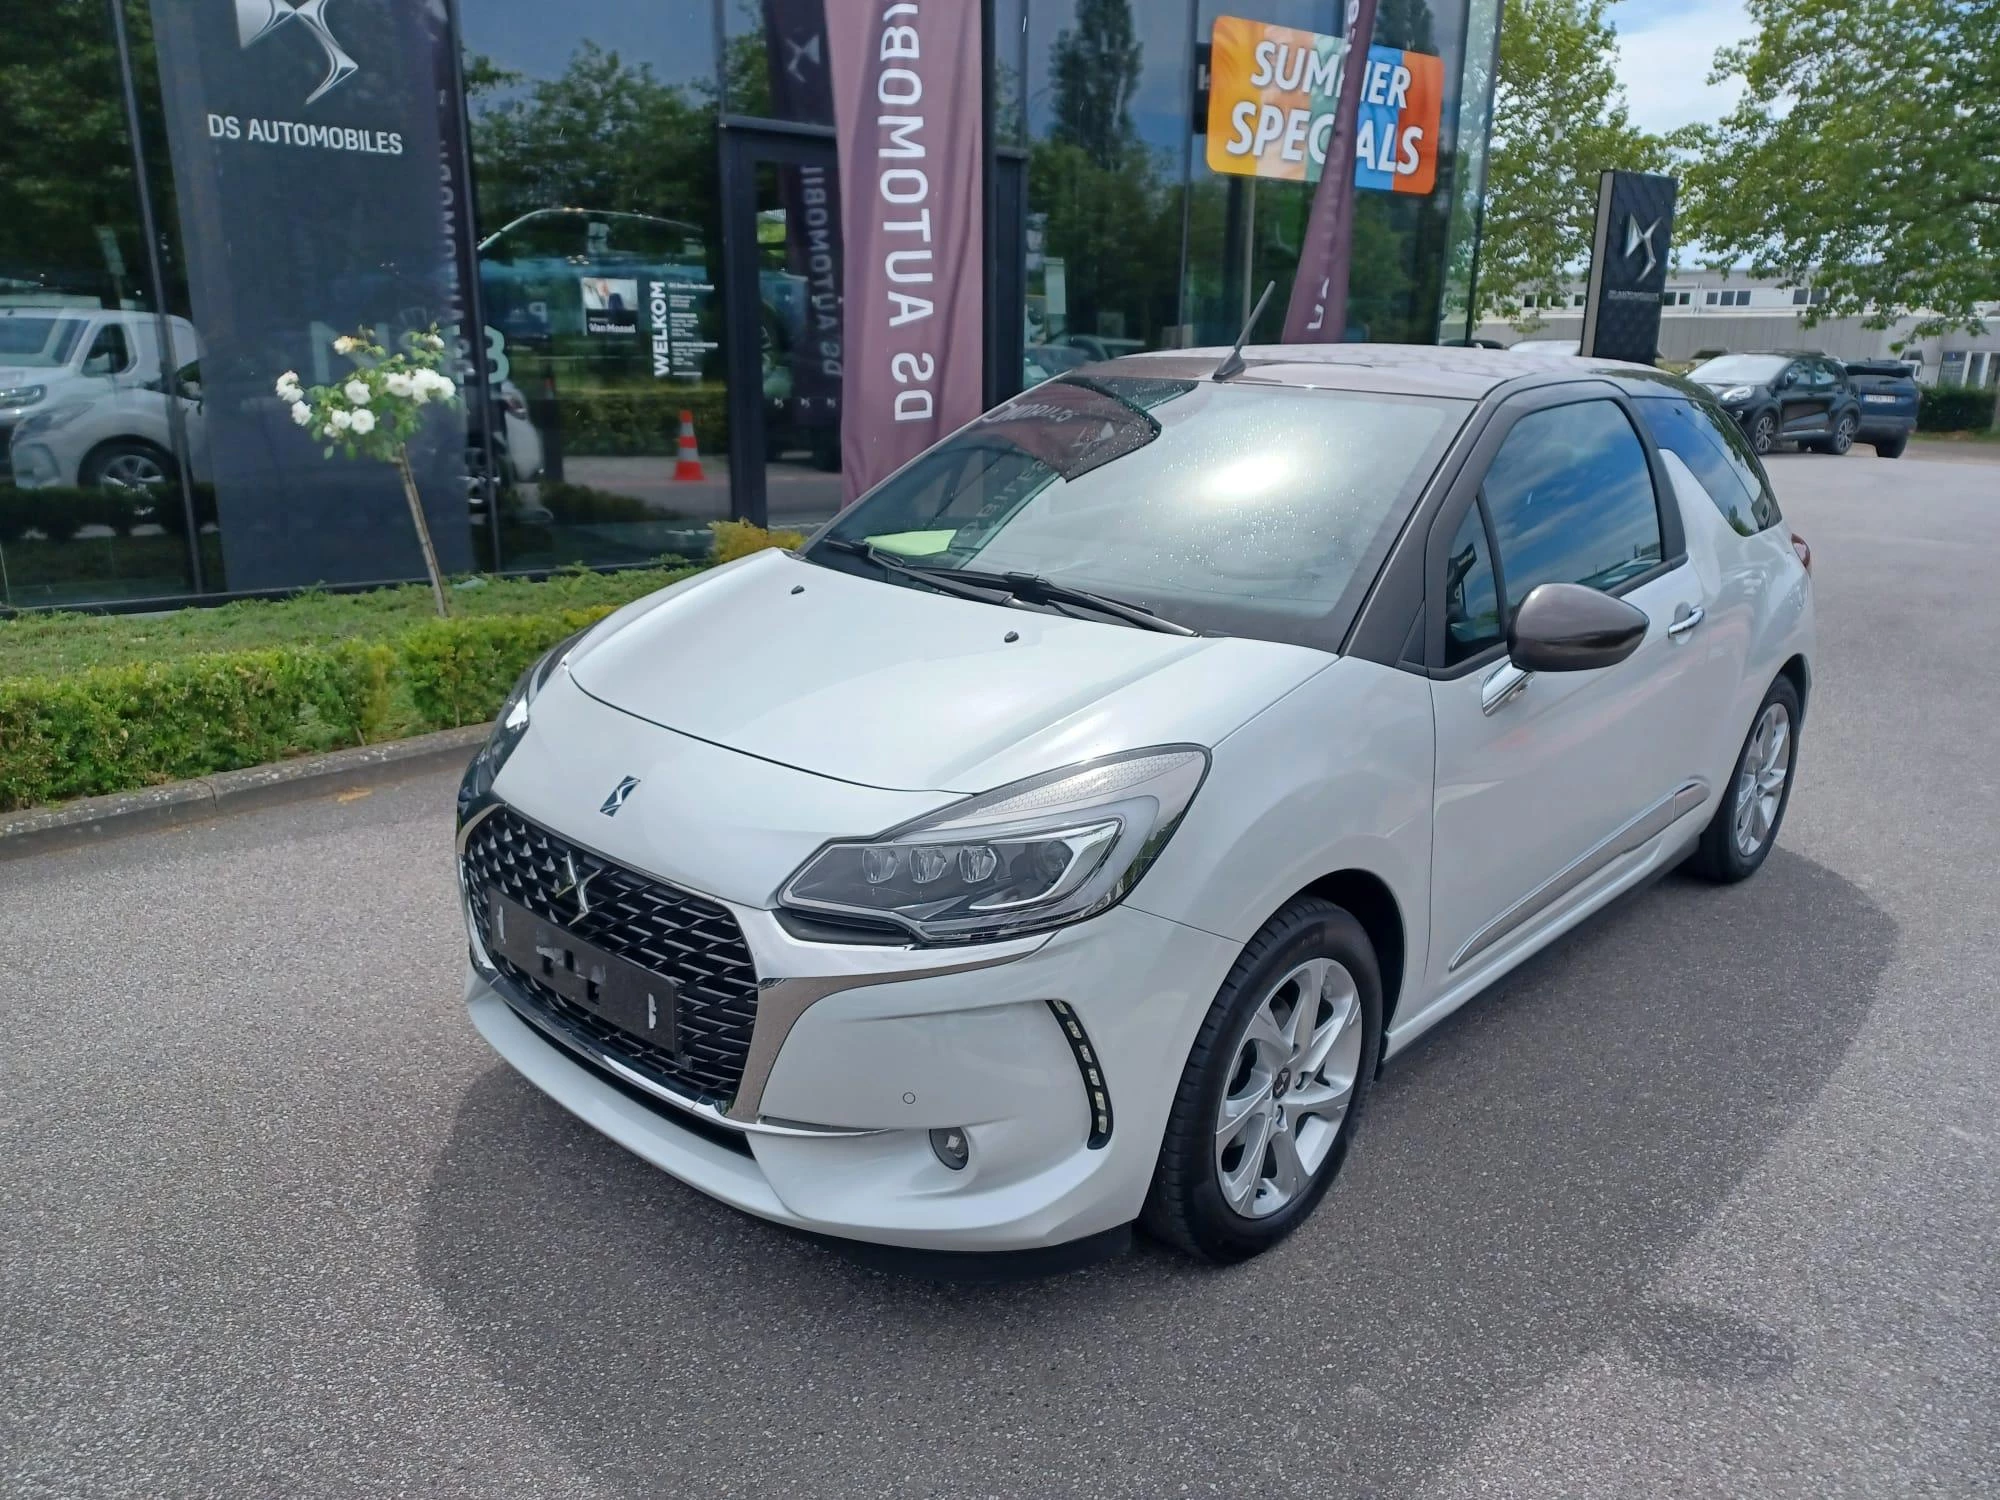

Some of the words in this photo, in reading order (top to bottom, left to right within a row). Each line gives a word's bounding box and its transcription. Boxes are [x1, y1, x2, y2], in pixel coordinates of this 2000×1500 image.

[207, 113, 241, 139] DS
[248, 118, 403, 155] AUTOMOBILES
[1225, 100, 1424, 176] SPECALS
[649, 281, 670, 377] WELKOM
